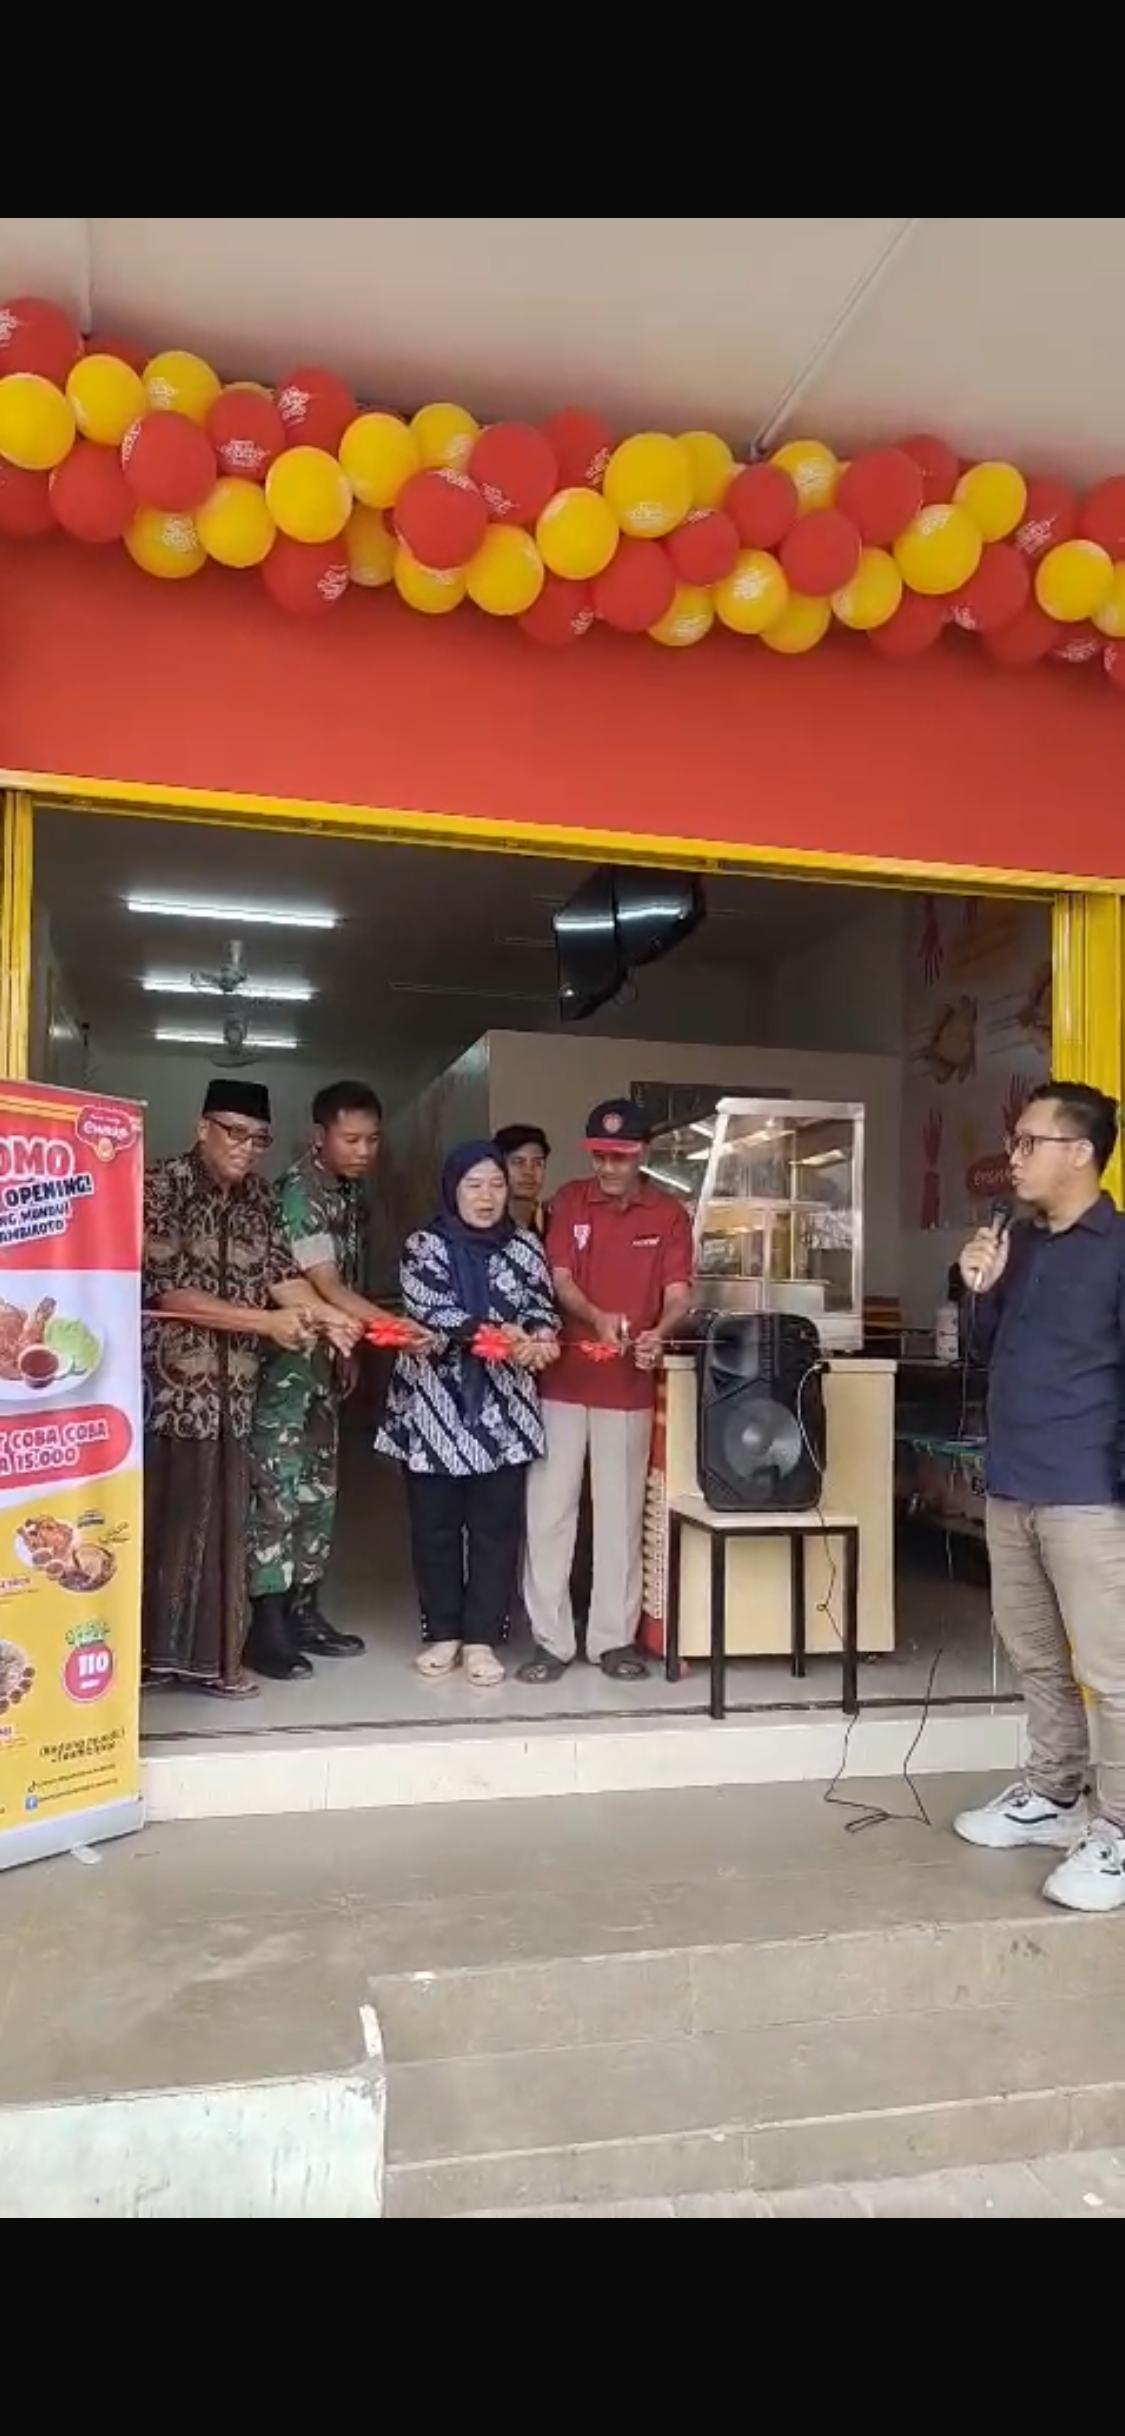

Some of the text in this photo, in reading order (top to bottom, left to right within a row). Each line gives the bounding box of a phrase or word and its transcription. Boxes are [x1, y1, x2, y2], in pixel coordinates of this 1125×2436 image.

[5, 1175, 92, 1206] OPENING!
[12, 1428, 58, 1449] COBA
[65, 1422, 106, 1442] COBA
